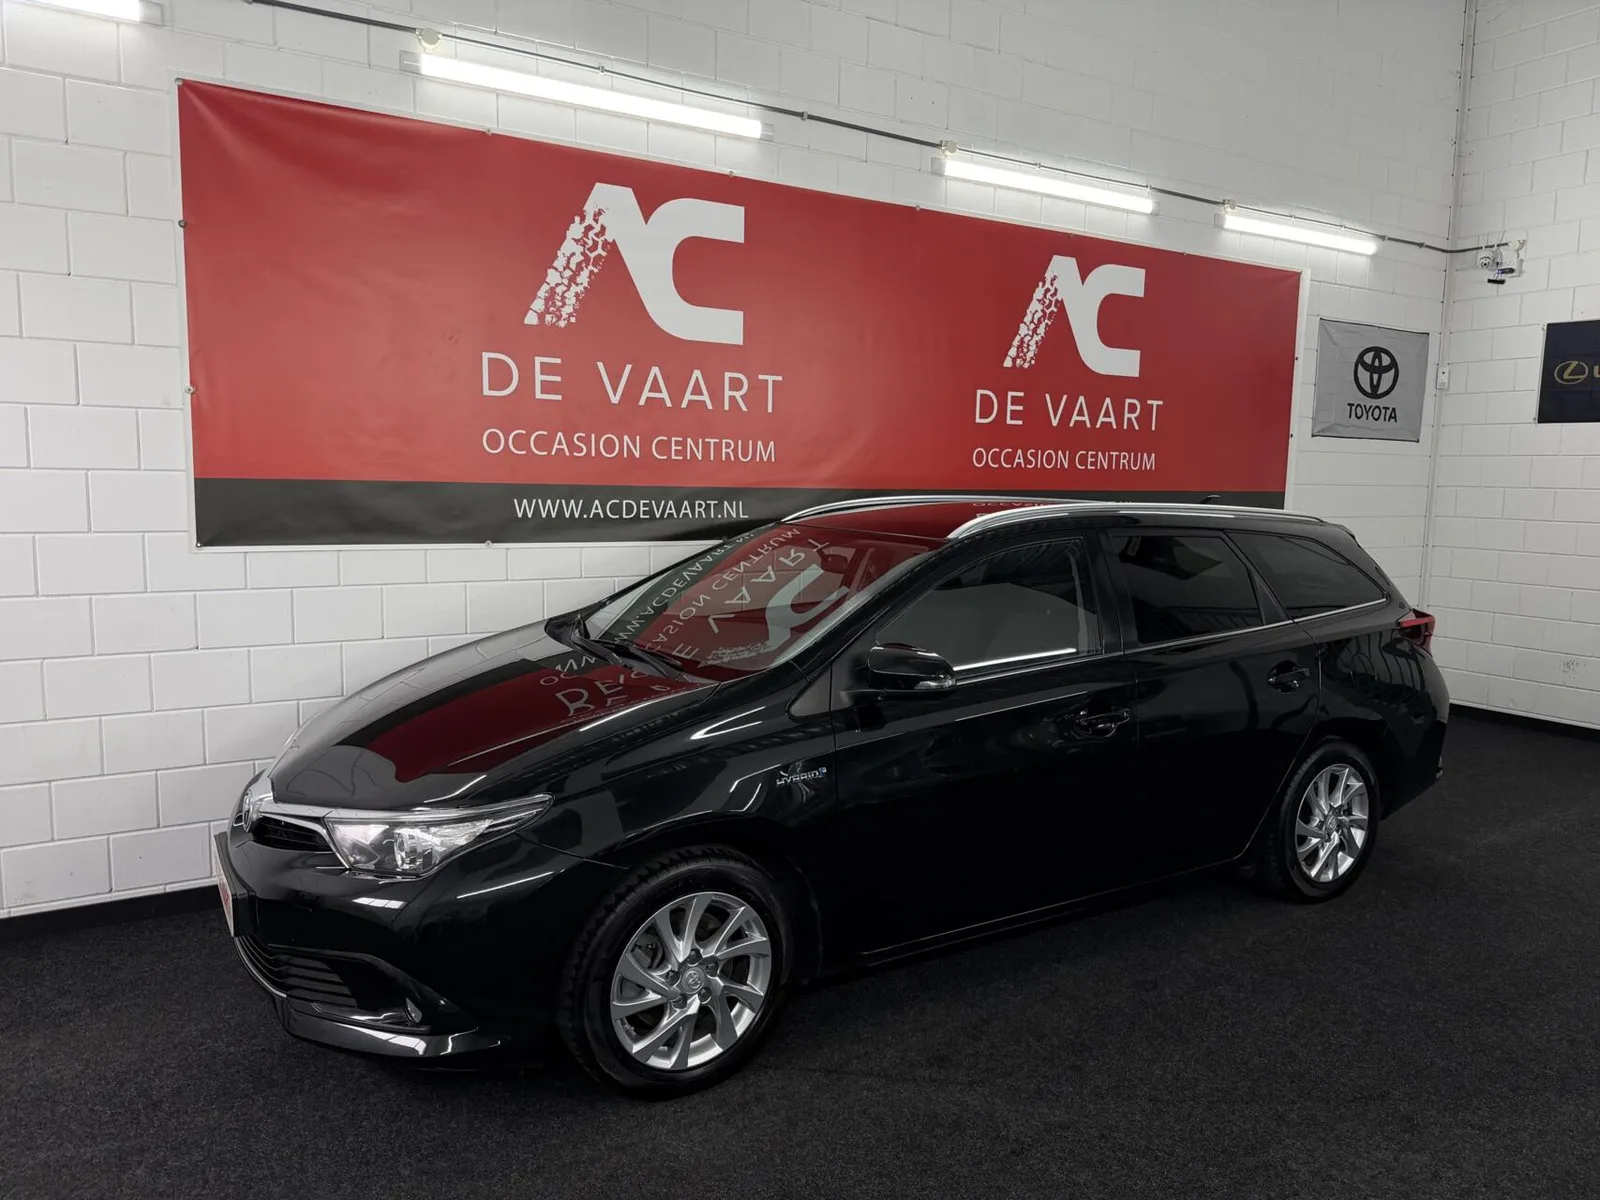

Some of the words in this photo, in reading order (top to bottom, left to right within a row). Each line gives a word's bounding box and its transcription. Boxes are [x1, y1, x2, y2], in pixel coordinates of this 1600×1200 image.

[482, 351, 562, 401] DE
[597, 361, 783, 413] VAART
[975, 389, 1025, 425] DE
[1045, 393, 1164, 431] VAART
[1347, 403, 1398, 423] TOYOTA
[482, 428, 640, 459] OCCASION
[651, 436, 776, 462] CENTRUM
[973, 447, 1069, 469] OCCASION
[1075, 451, 1156, 470] CENTRUM
[514, 498, 749, 520] WWW.ACDEVAART.NL
